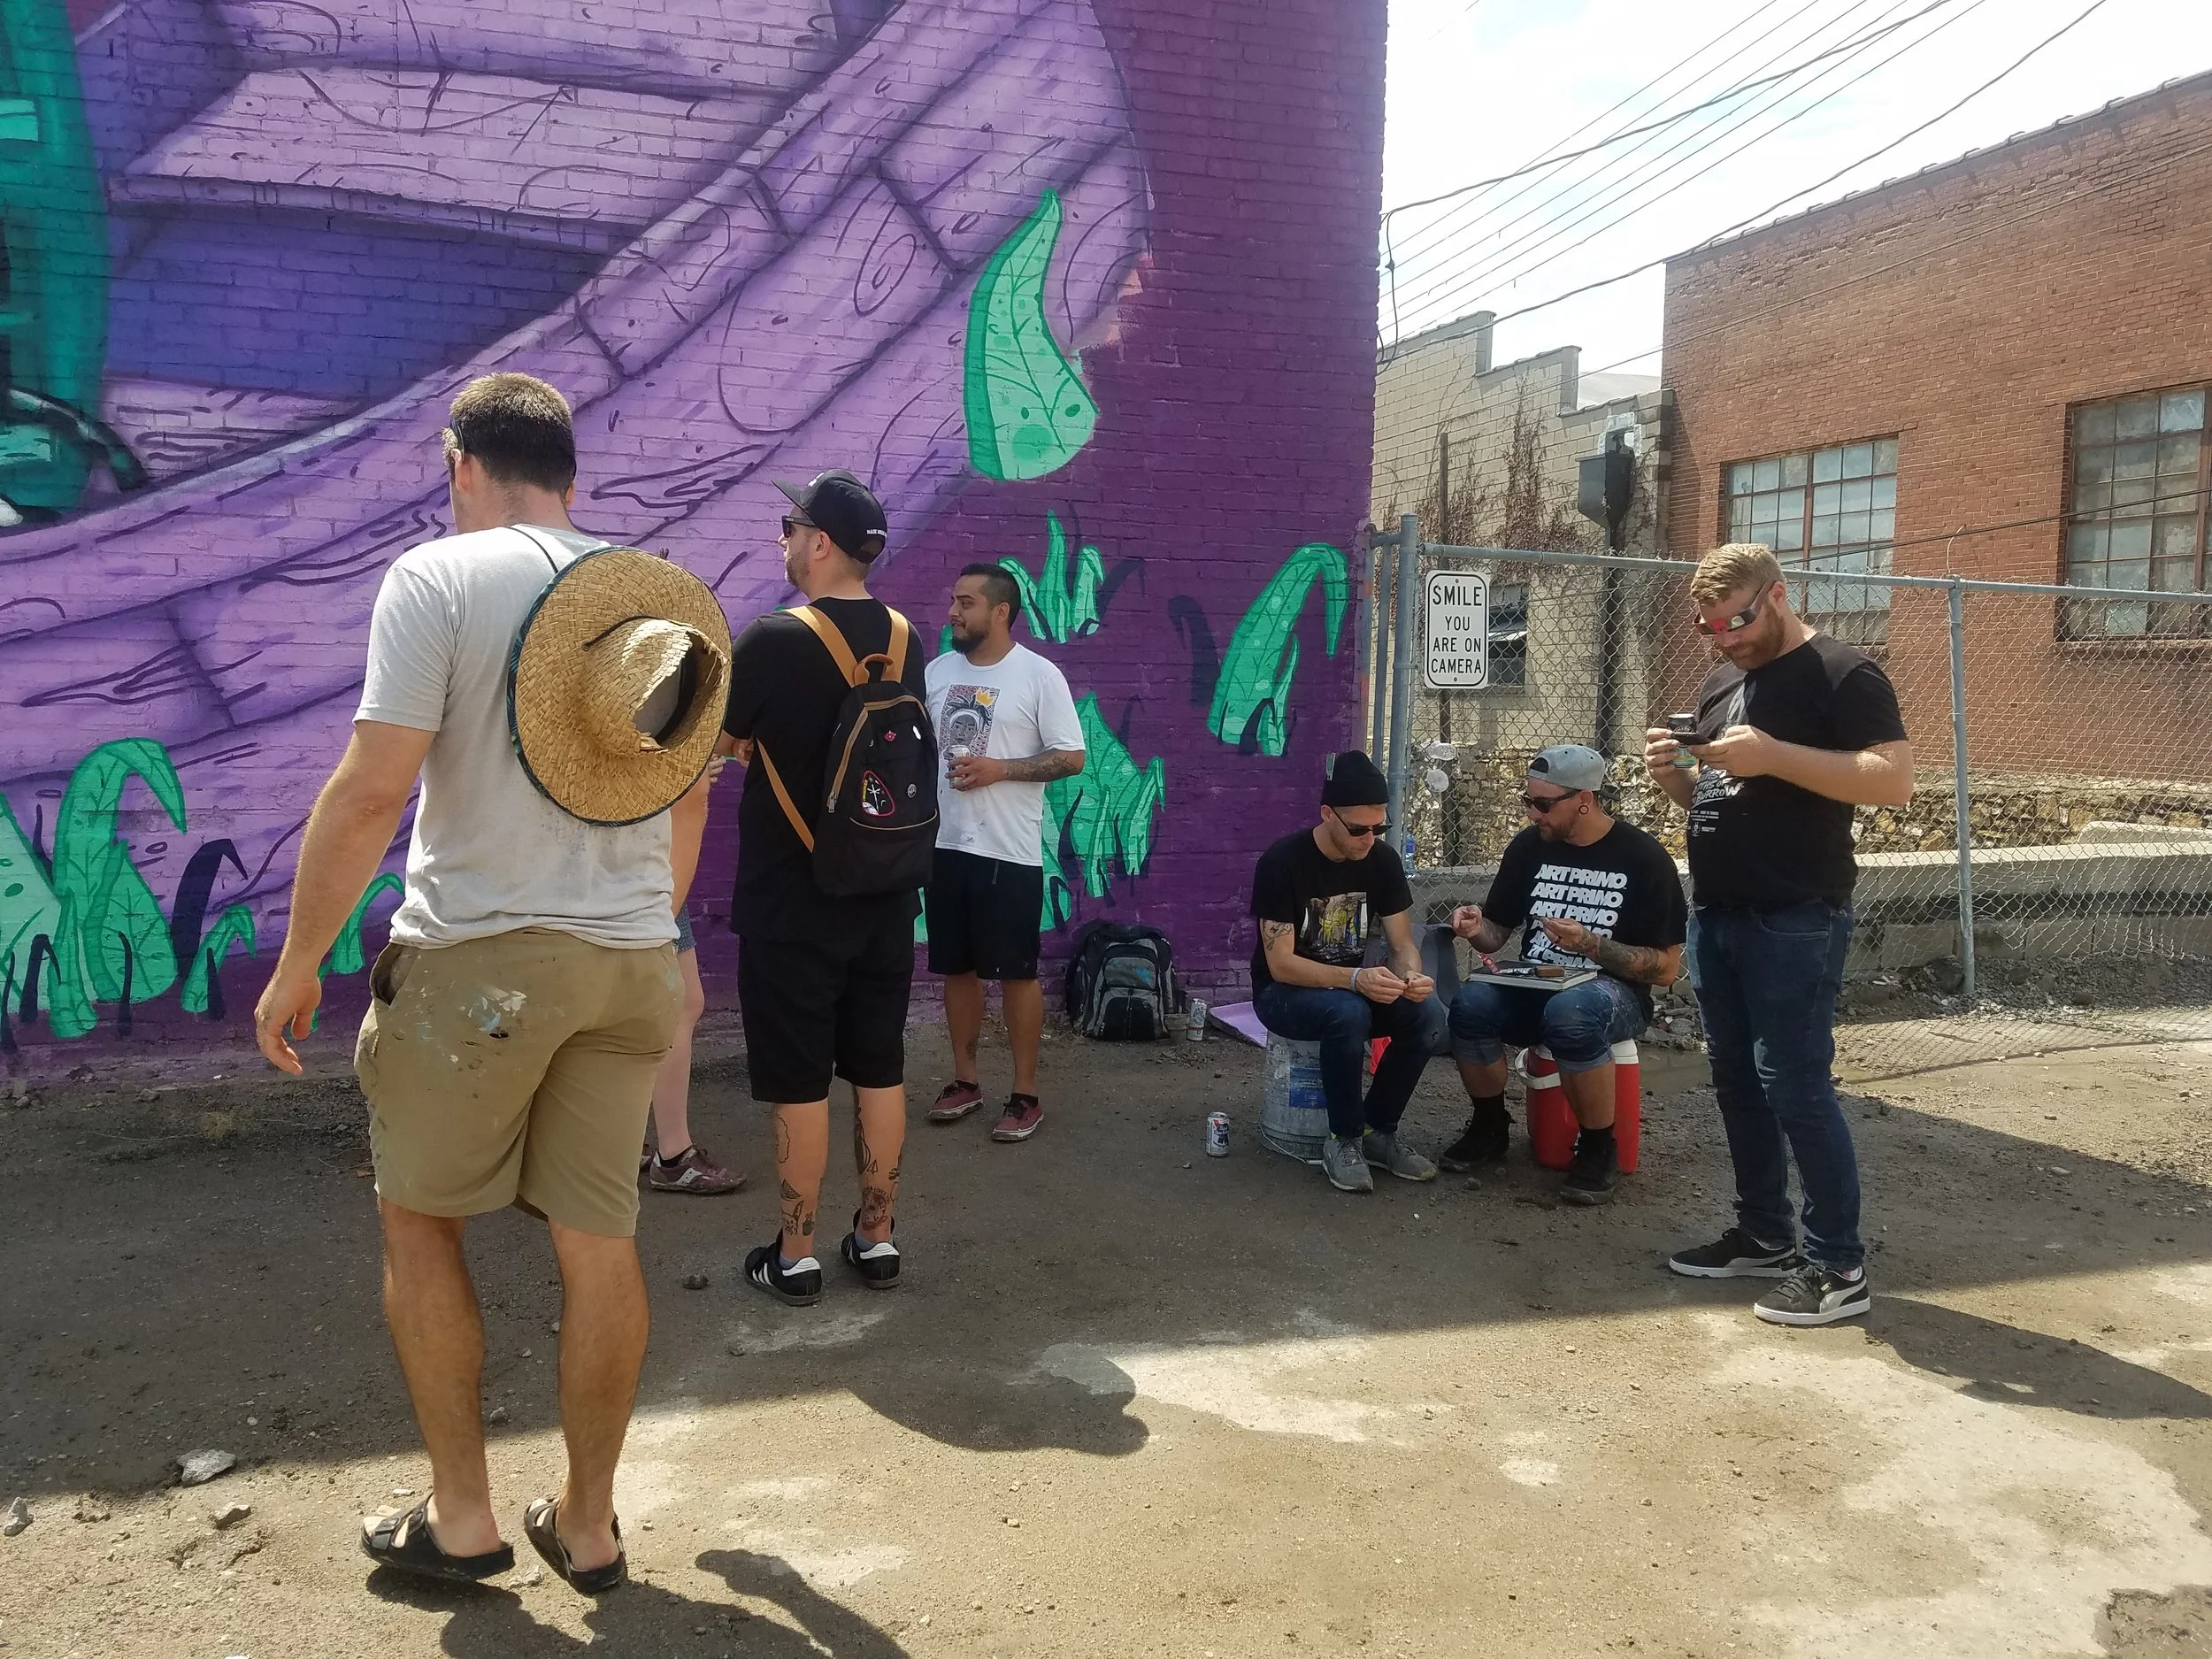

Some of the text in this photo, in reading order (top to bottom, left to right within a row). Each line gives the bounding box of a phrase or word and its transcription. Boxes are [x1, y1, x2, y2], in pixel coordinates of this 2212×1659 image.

[1432, 585, 1482, 606] SMILE
[1445, 616, 1470, 631] YOU
[1433, 637, 1481, 653] ARE ON
[1431, 658, 1482, 673] CAMERA
[1533, 864, 1627, 889] ART PRIMO
[1530, 881, 1624, 908] ART PRIMO
[1529, 900, 1567, 918] ART
